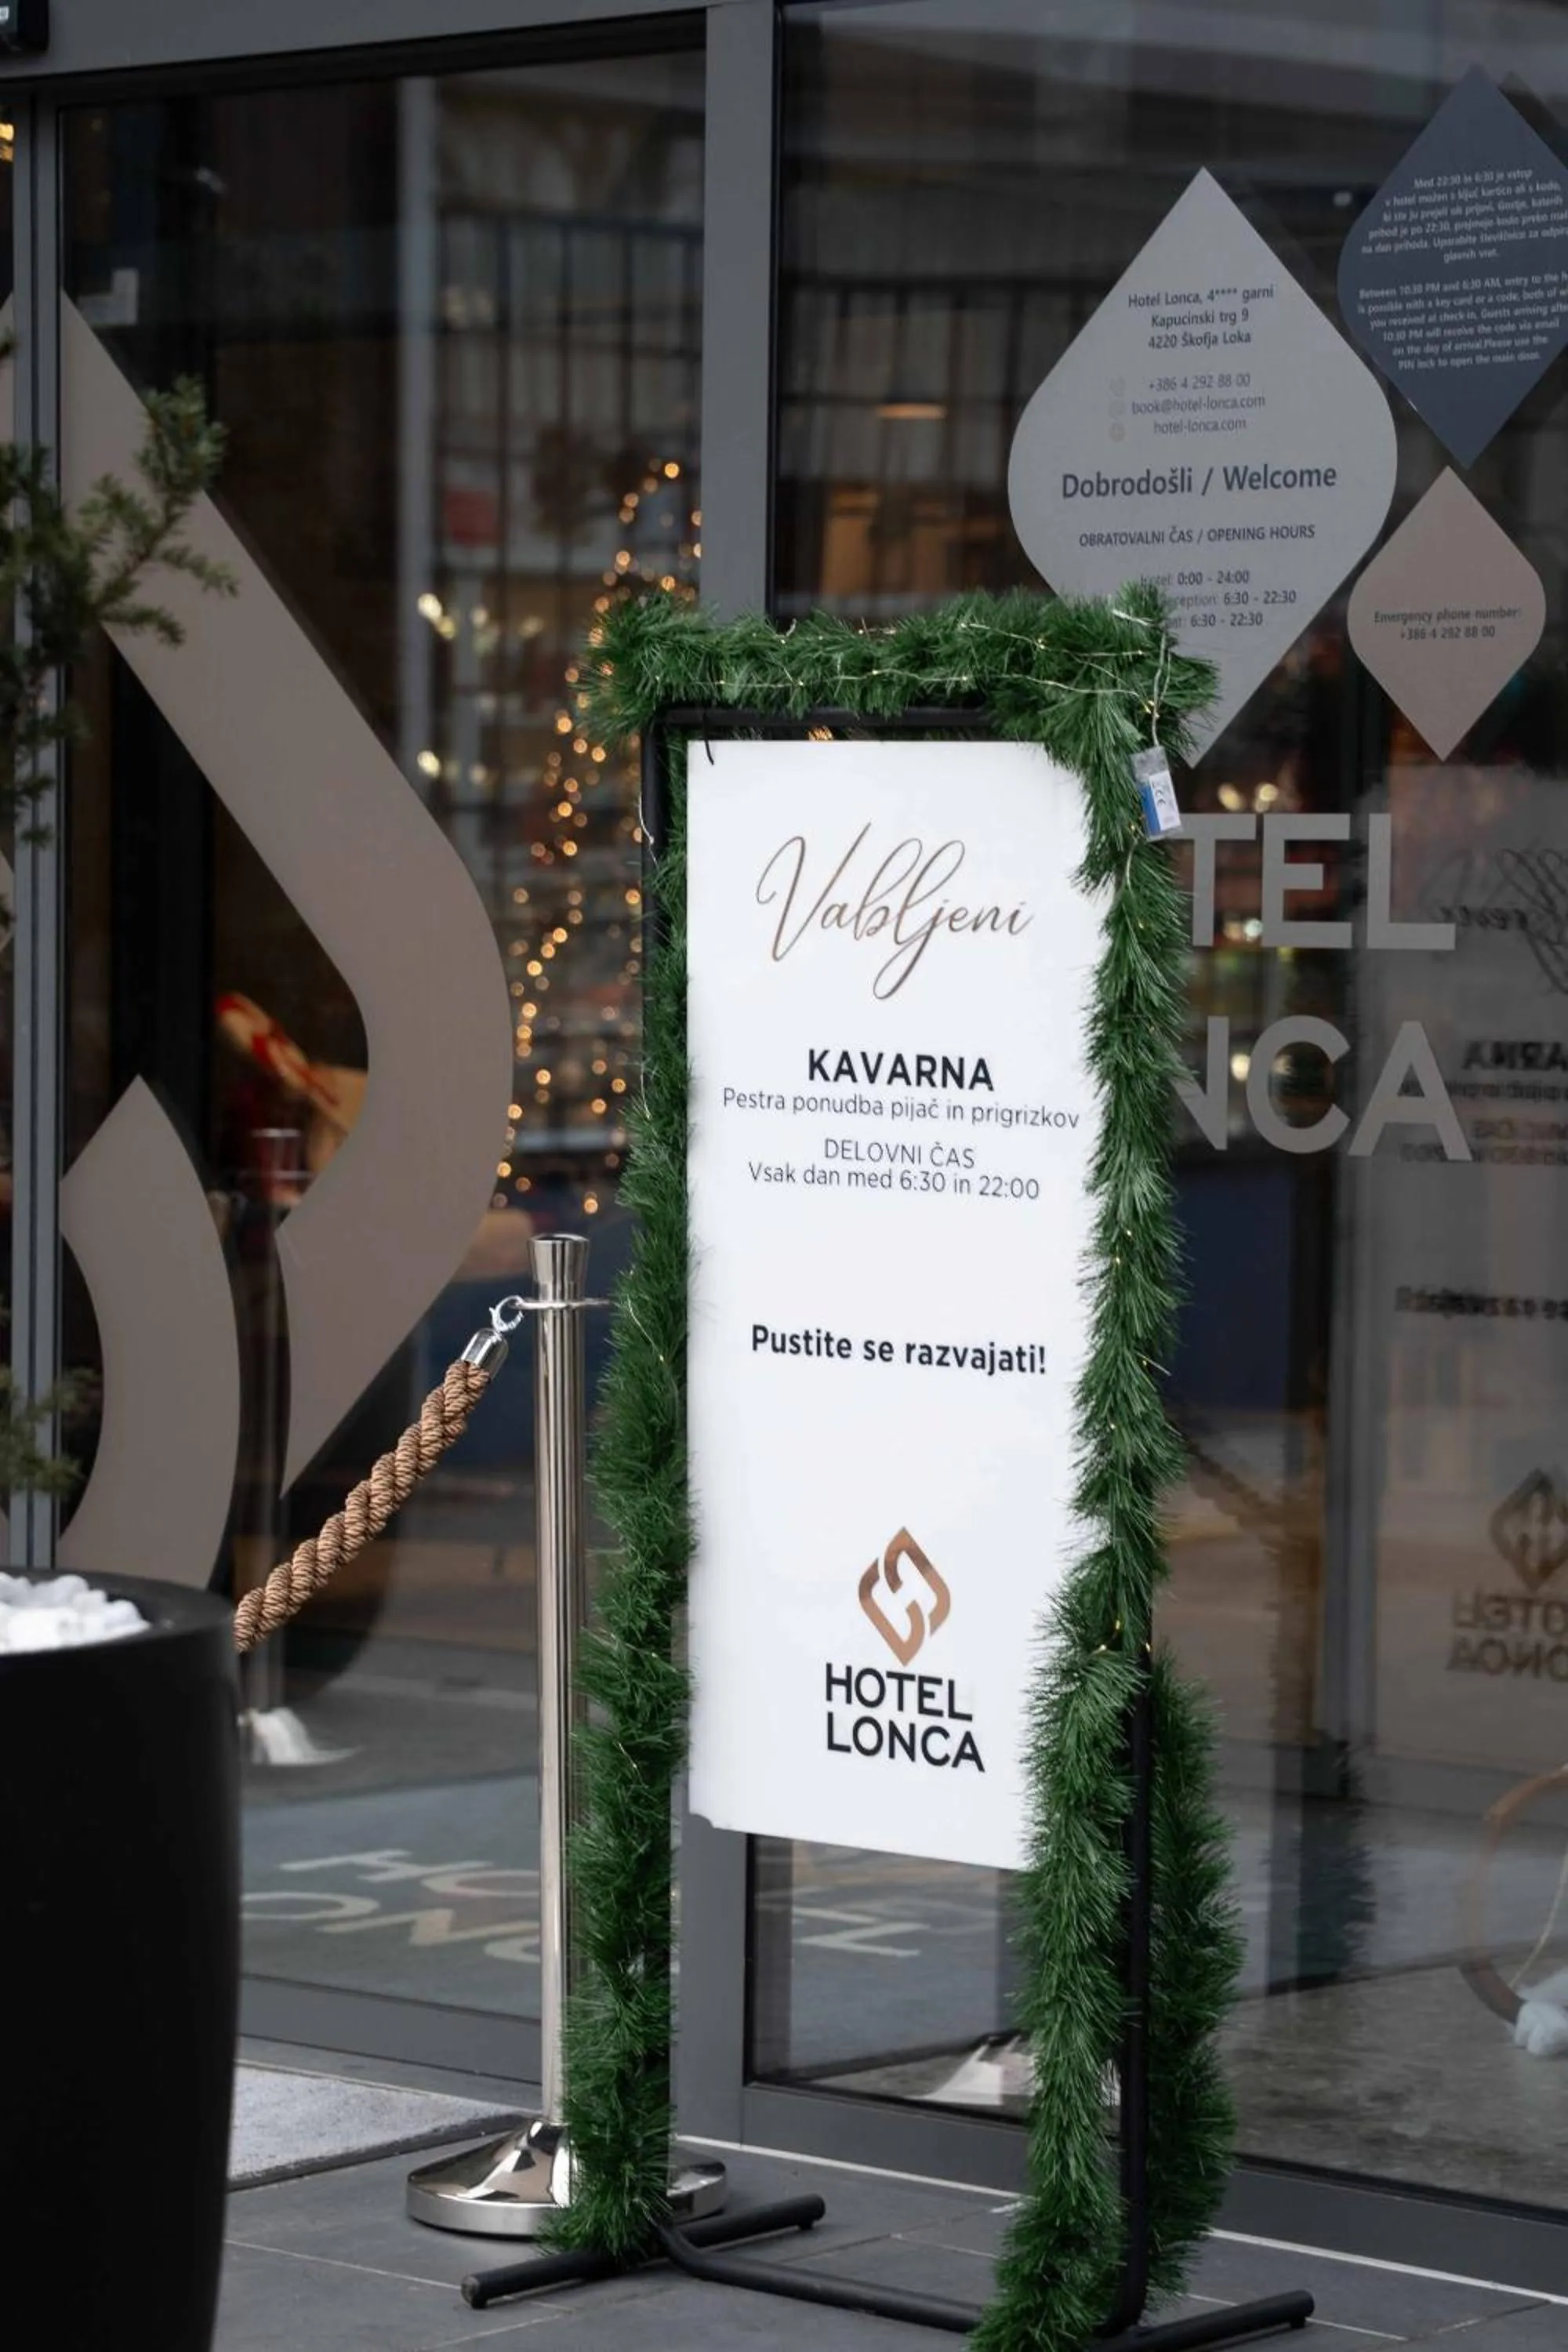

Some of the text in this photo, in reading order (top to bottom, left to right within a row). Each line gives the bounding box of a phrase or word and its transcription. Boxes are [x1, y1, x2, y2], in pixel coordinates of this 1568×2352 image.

[1128, 292, 1160, 307] Hotel
[1164, 291, 1203, 305] Lonca,
[1241, 284, 1274, 303] garni
[1151, 308, 1249, 329] Kapucinski trg 9
[1148, 330, 1251, 349] 4220 Škofja Loka
[1149, 372, 1251, 391] +386 4 292 88 00
[1131, 396, 1265, 415] book@hotel-lonca.com
[1153, 419, 1247, 434] hotel-lonca.com
[1062, 463, 1337, 499] Dobrodošli / Welcome
[1079, 524, 1316, 547] OBRATOVALNI ČAS / OPENING HOURS
[1178, 572, 1203, 586] 0:00
[1217, 570, 1250, 584] 24:00
[1224, 591, 1249, 605] 6:30
[1263, 590, 1297, 604] 22:30
[1190, 615, 1216, 627] 6:30
[1230, 612, 1263, 626] 22:30
[1374, 611, 1433, 625] Emergency
[1436, 608, 1471, 622] phone
[1441, 626, 1461, 639] 292
[1481, 626, 1495, 637] 00
[1168, 812, 1456, 950] TEL
[757, 822, 1033, 1000] Vabljeni
[808, 1048, 994, 1091] KAVARNA
[1169, 1015, 1472, 1161] NCA
[723, 1087, 1080, 1129] Pestra ponudba pijač in prigrizkov
[825, 1138, 975, 1169] DELOVNI ČAS
[749, 1162, 1040, 1200] Vsak dan med 6:30 in 22:00
[752, 1324, 1046, 1377] Pustite se razvajati!
[826, 1662, 973, 1722] HOTEL
[827, 1711, 985, 1773] LONCA
